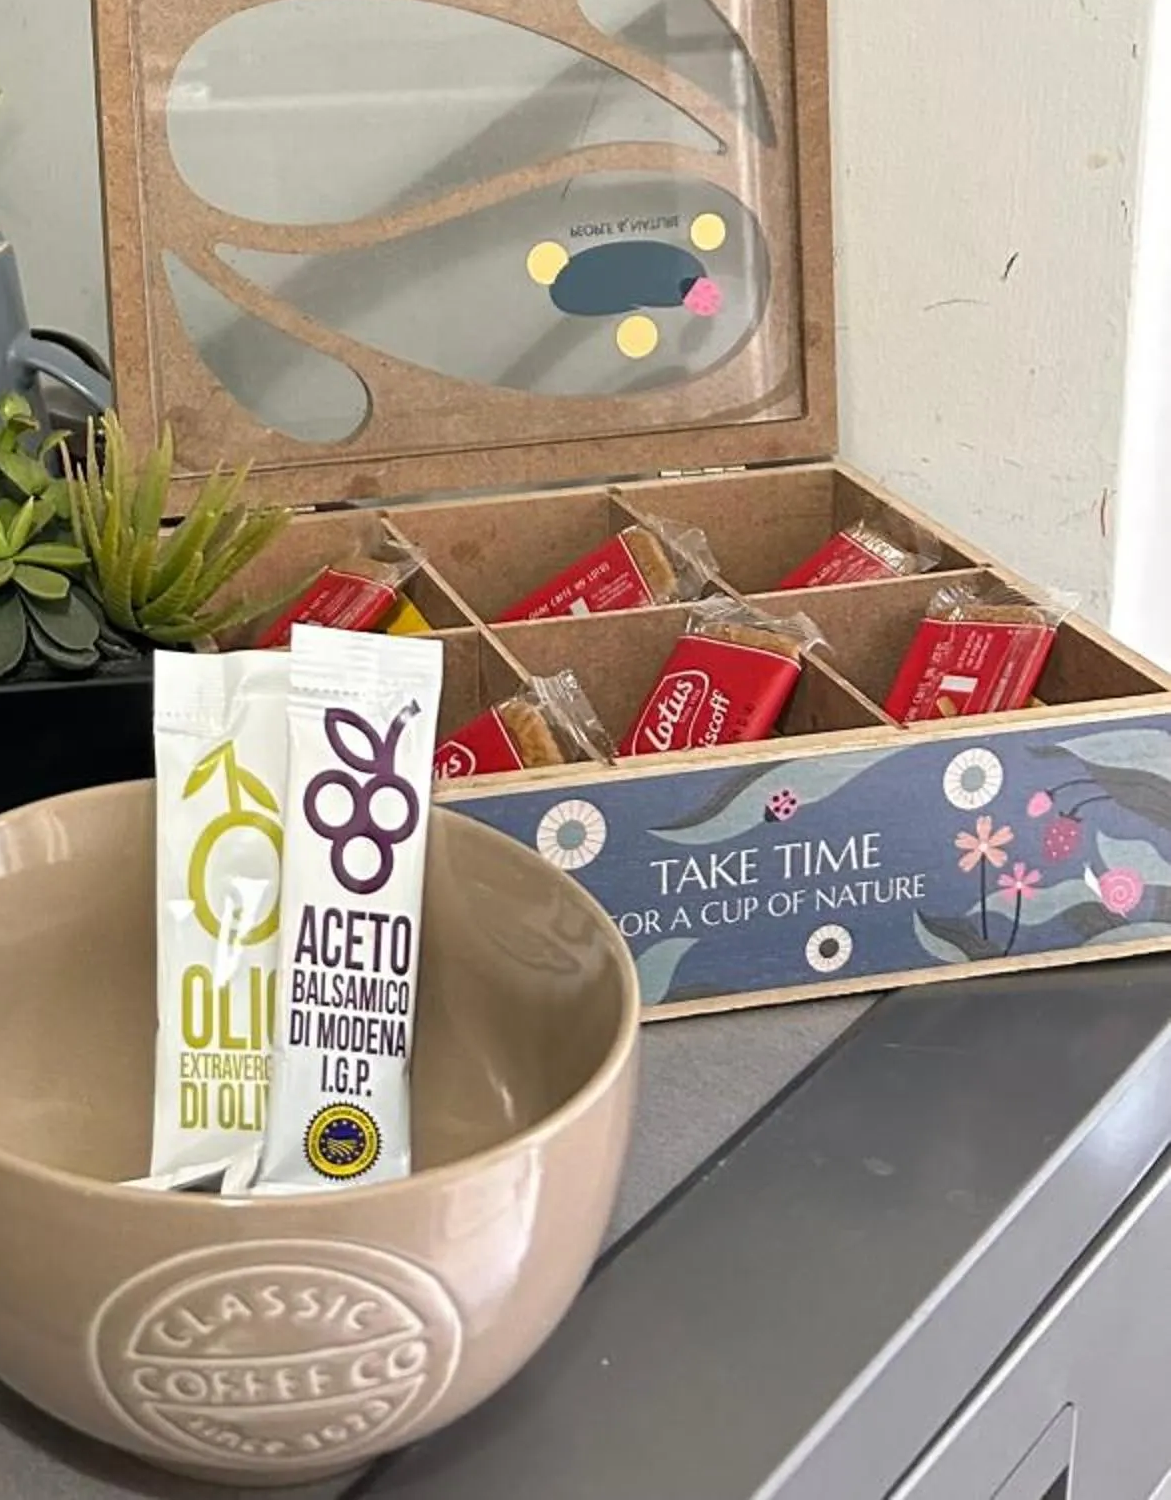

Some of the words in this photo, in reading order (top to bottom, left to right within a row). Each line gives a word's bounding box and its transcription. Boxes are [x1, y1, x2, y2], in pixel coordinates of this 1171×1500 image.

[698, 688, 731, 749] iscoff
[649, 847, 759, 897] TAKE
[774, 831, 883, 881] TIME
[608, 909, 663, 937] OR
[669, 905, 692, 931] A
[700, 897, 759, 928] CUP
[767, 888, 805, 918] OF
[814, 873, 927, 909] NATURE
[294, 903, 413, 977] ACETO
[292, 968, 411, 1016] BALSAMICO
[289, 1007, 313, 1048] DI
[316, 1011, 408, 1059] MODENA
[320, 1053, 374, 1098] I.G.P.
[180, 1080, 209, 1130] DI
[153, 1285, 381, 1349] CLASSIC
[131, 1366, 330, 1404] COFFEE
